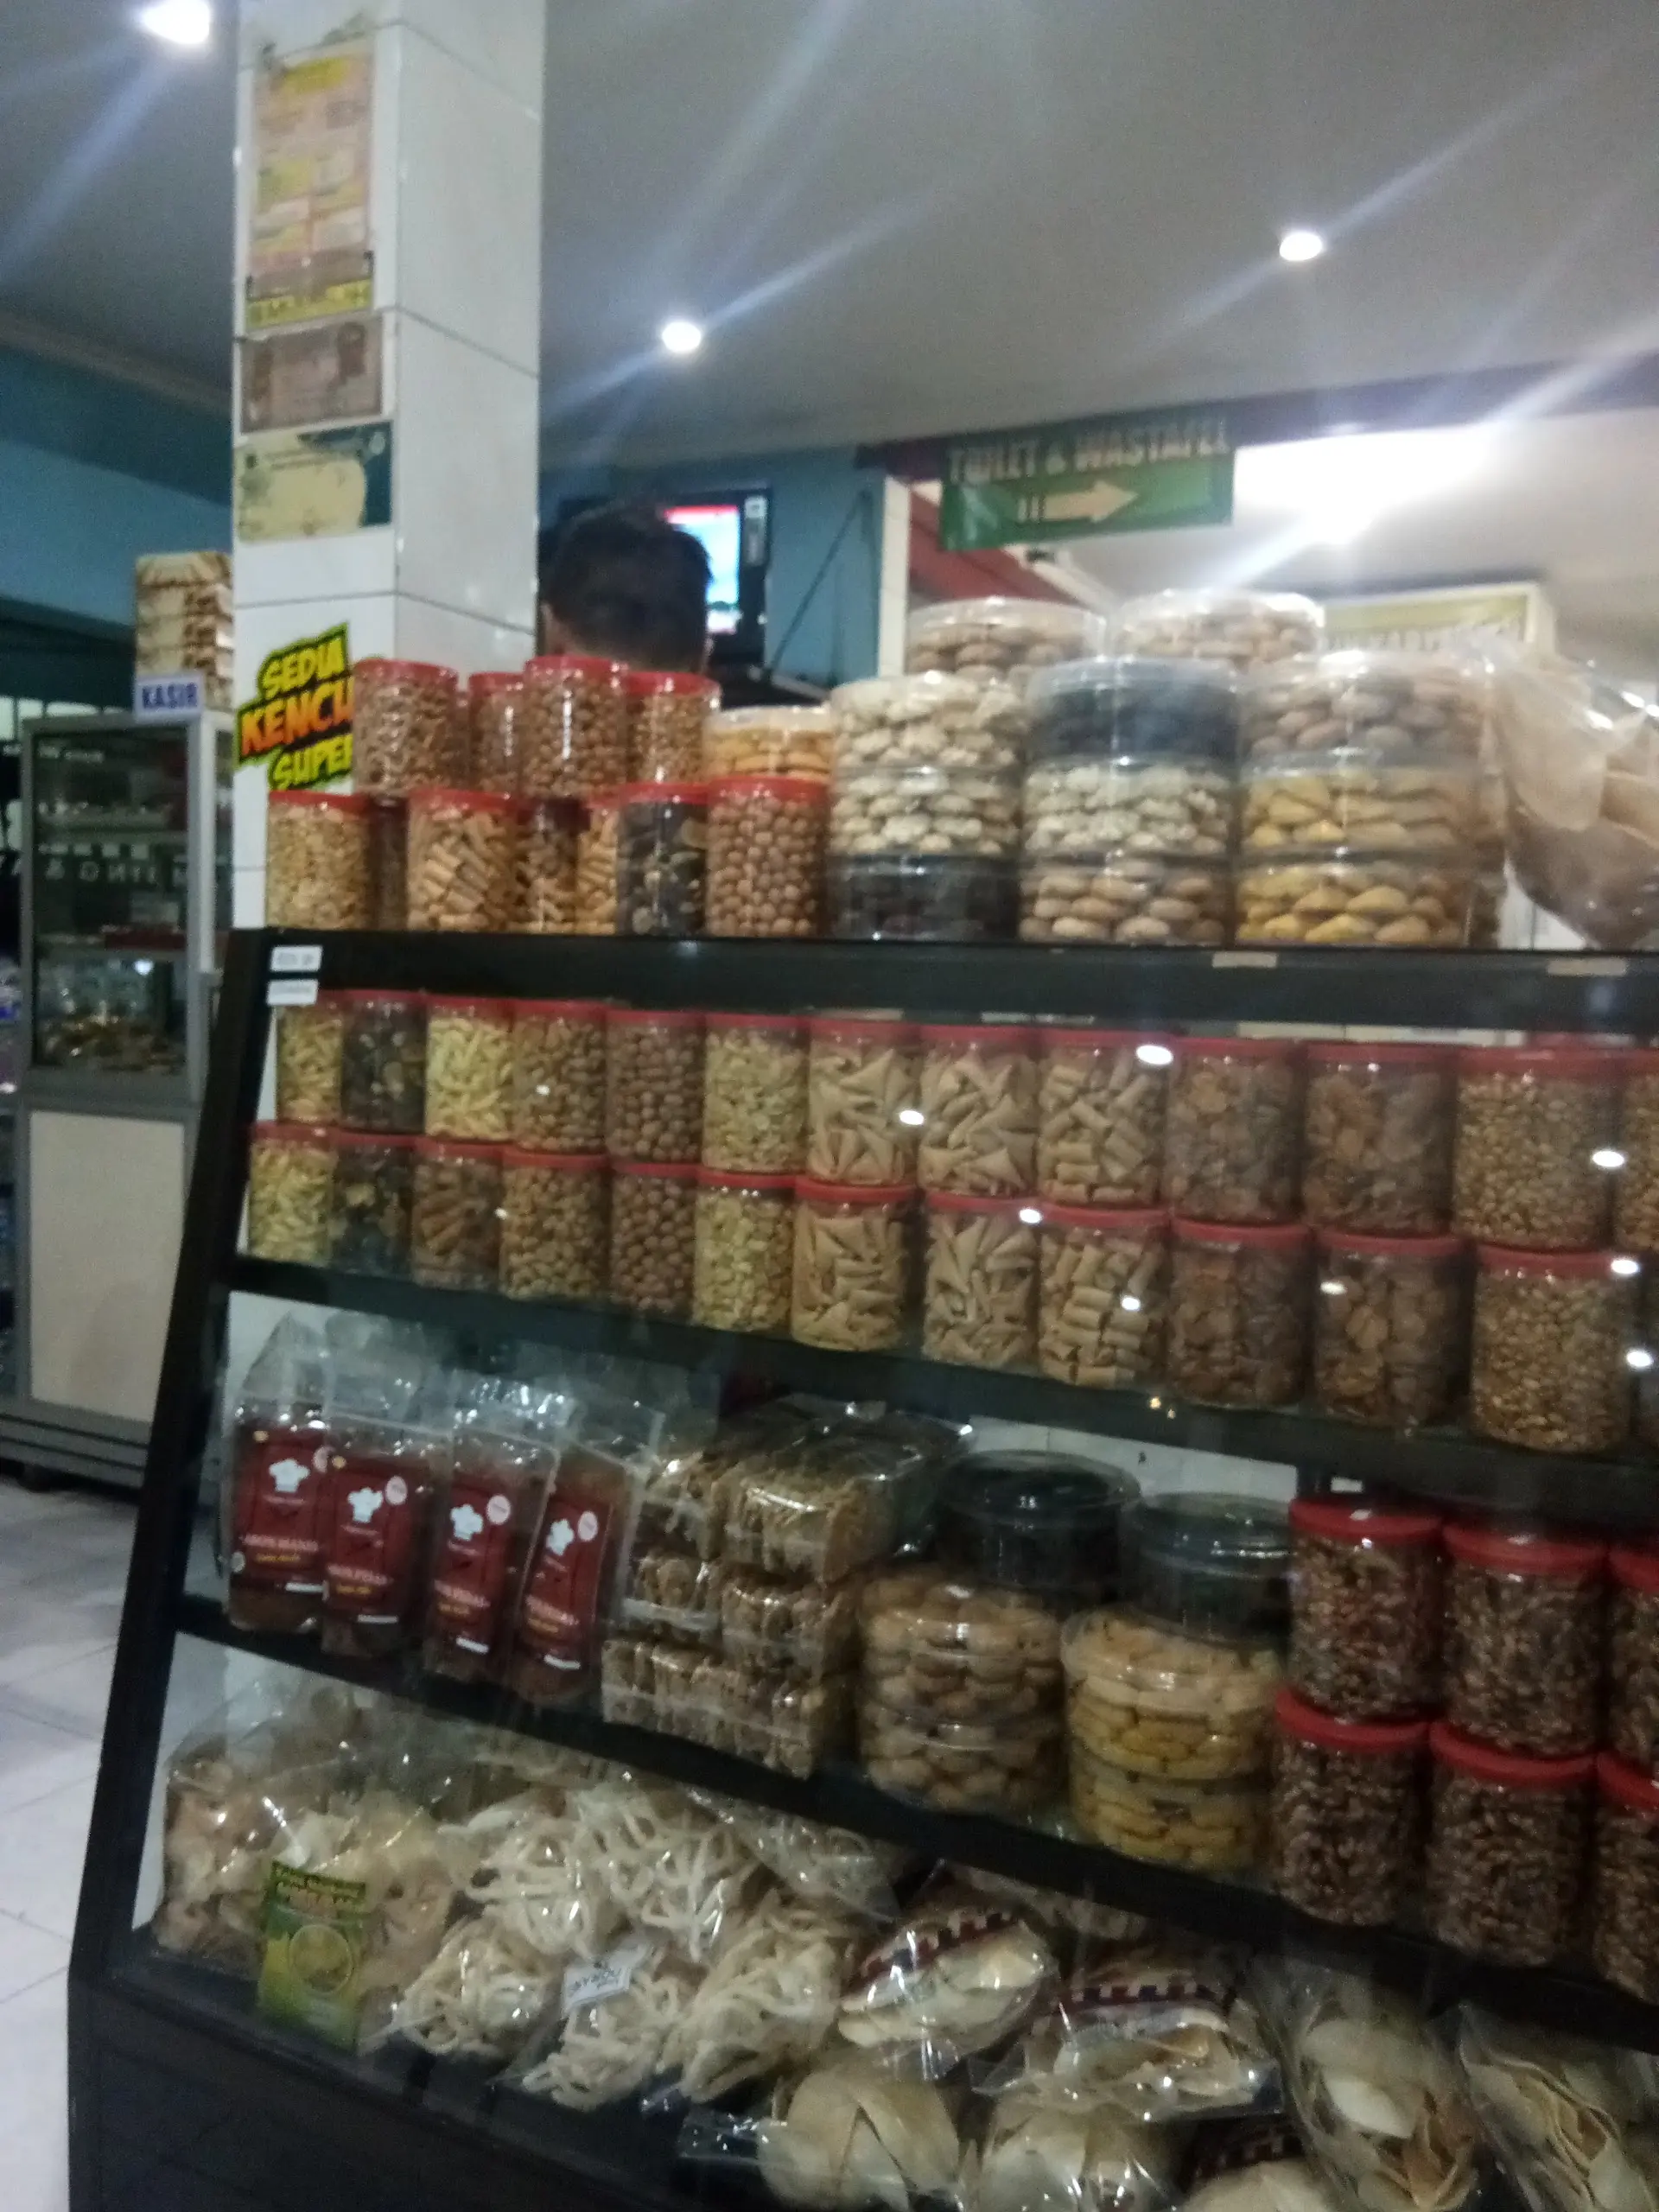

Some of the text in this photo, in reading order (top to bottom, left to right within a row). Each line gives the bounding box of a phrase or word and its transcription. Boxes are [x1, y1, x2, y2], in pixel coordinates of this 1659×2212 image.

[142, 682, 198, 709] KASIR
[263, 638, 345, 701] SEDIA
[241, 674, 355, 756] KENCU
